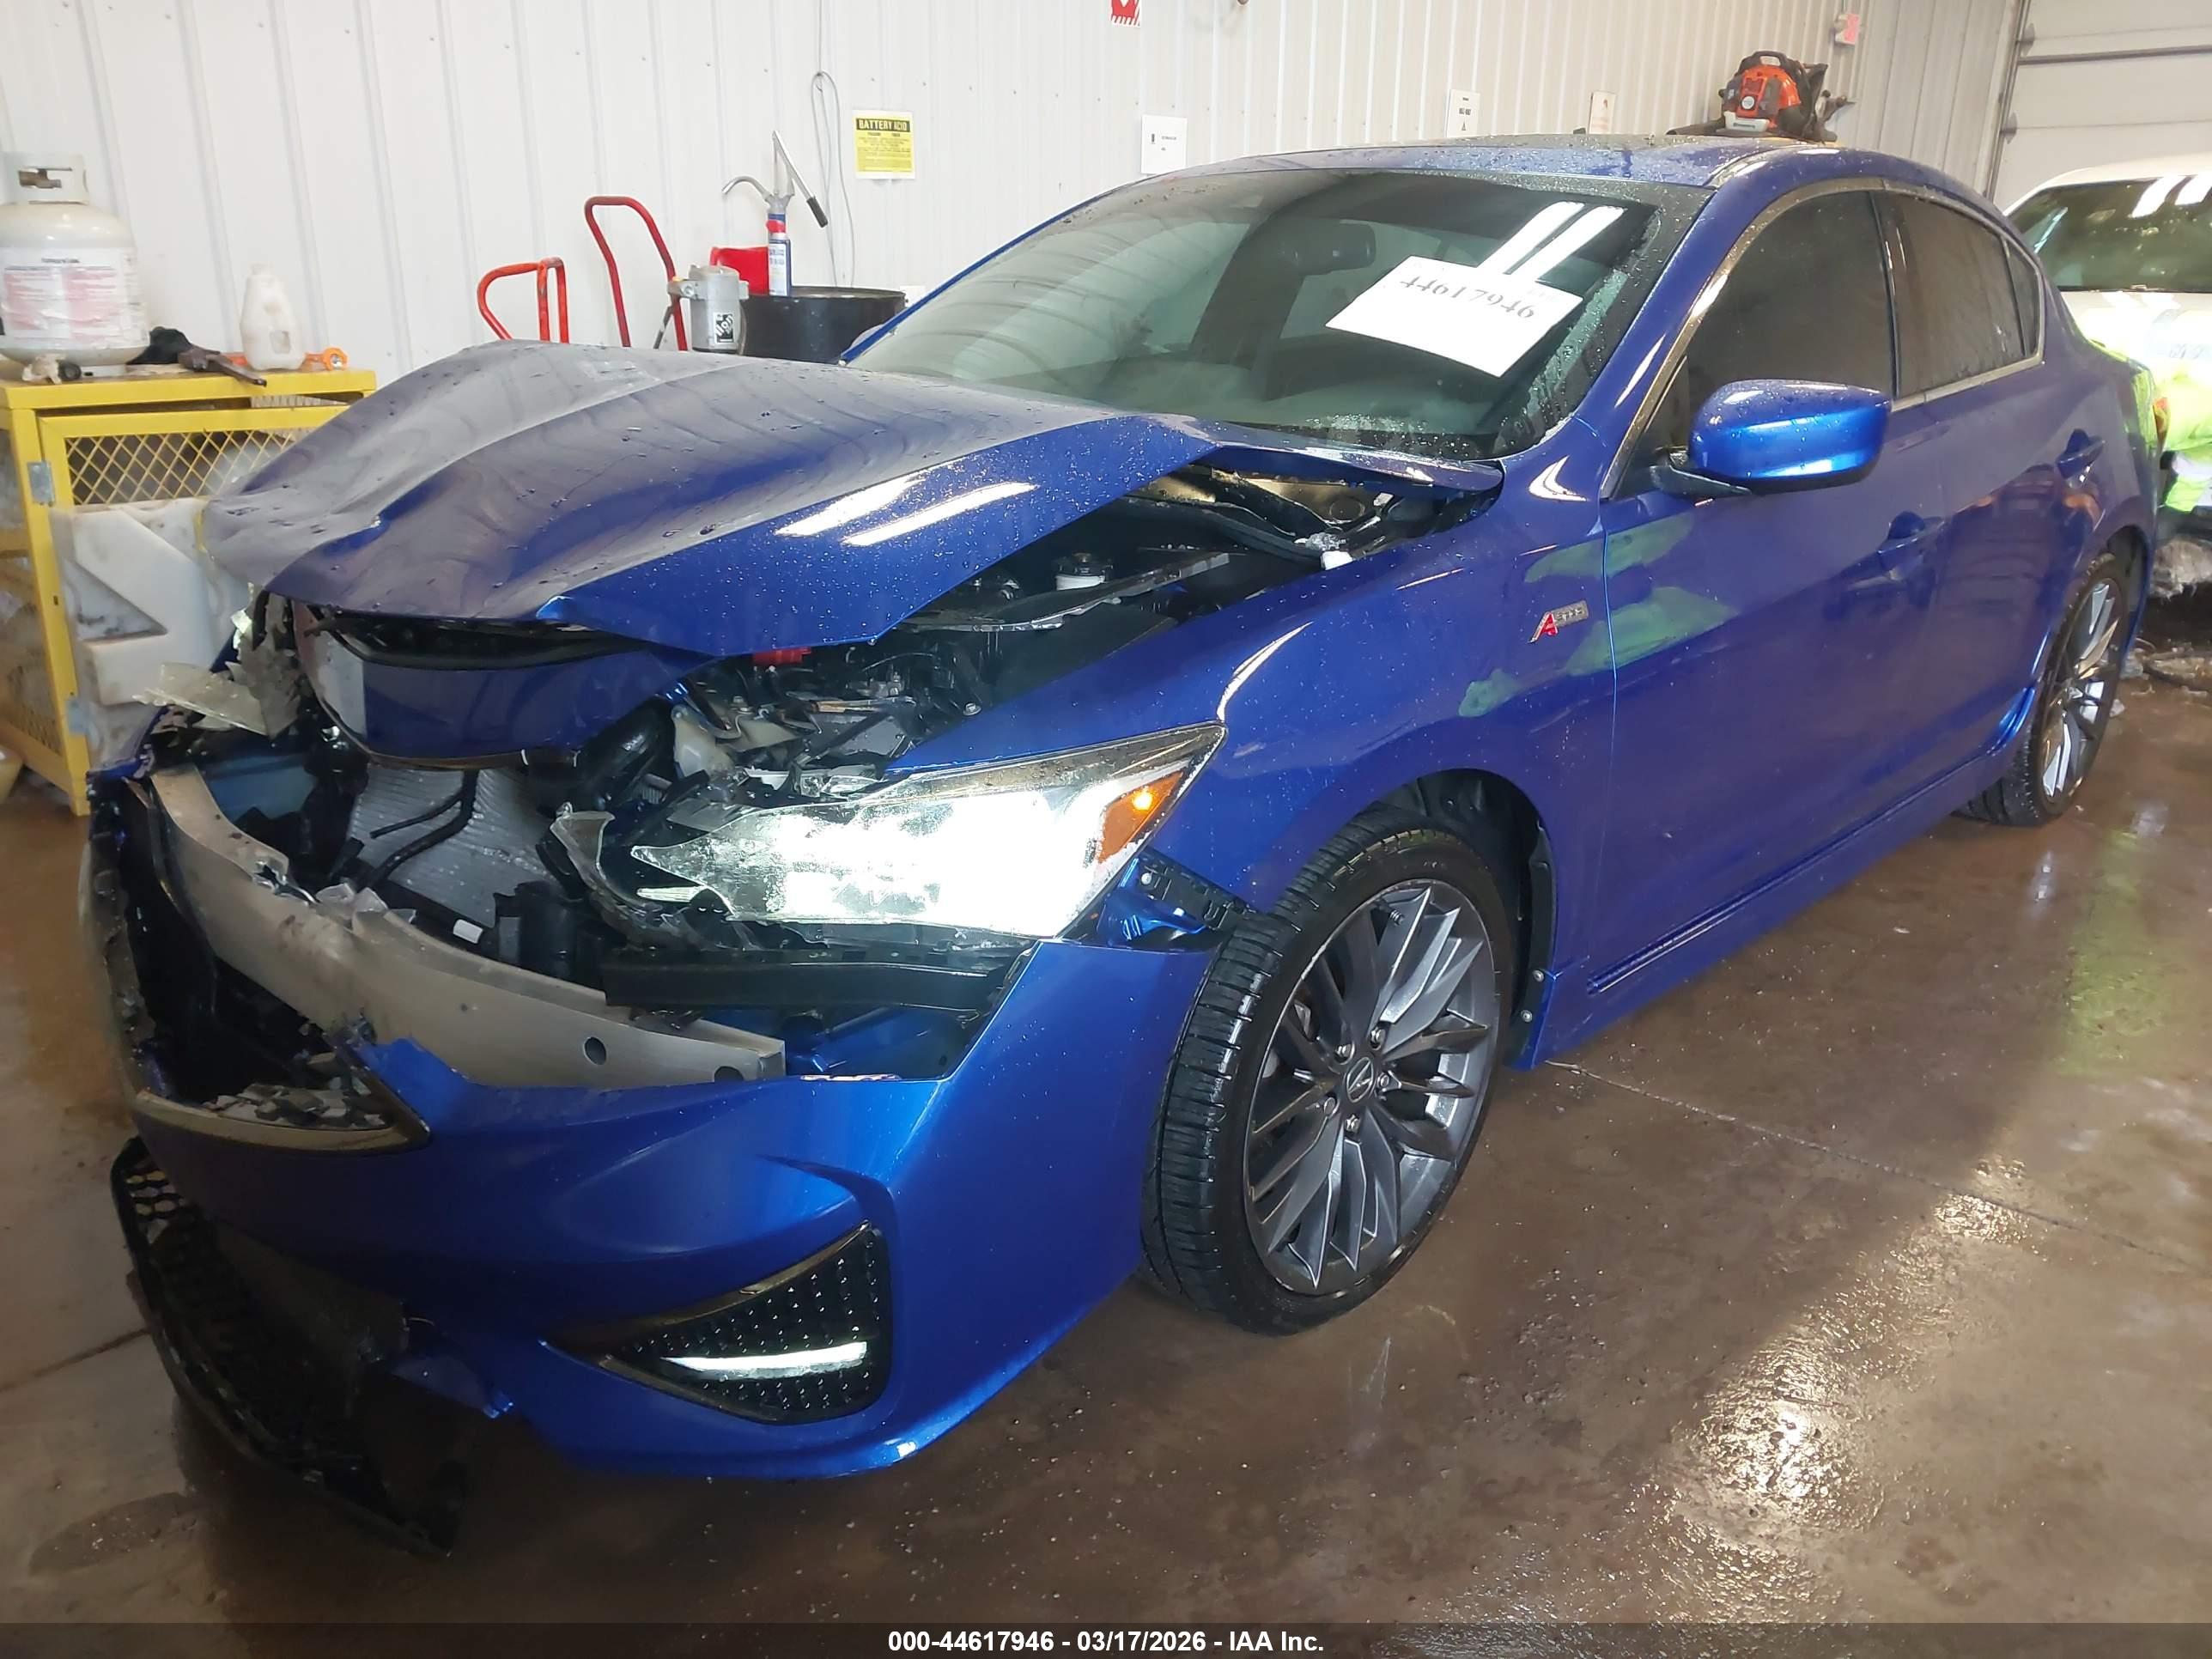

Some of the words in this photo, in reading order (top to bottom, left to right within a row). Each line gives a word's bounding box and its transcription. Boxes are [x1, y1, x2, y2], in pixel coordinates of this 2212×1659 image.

[859, 119, 892, 131] BATTERY
[894, 121, 908, 131] ACID
[1400, 276, 1534, 319] 44617946
